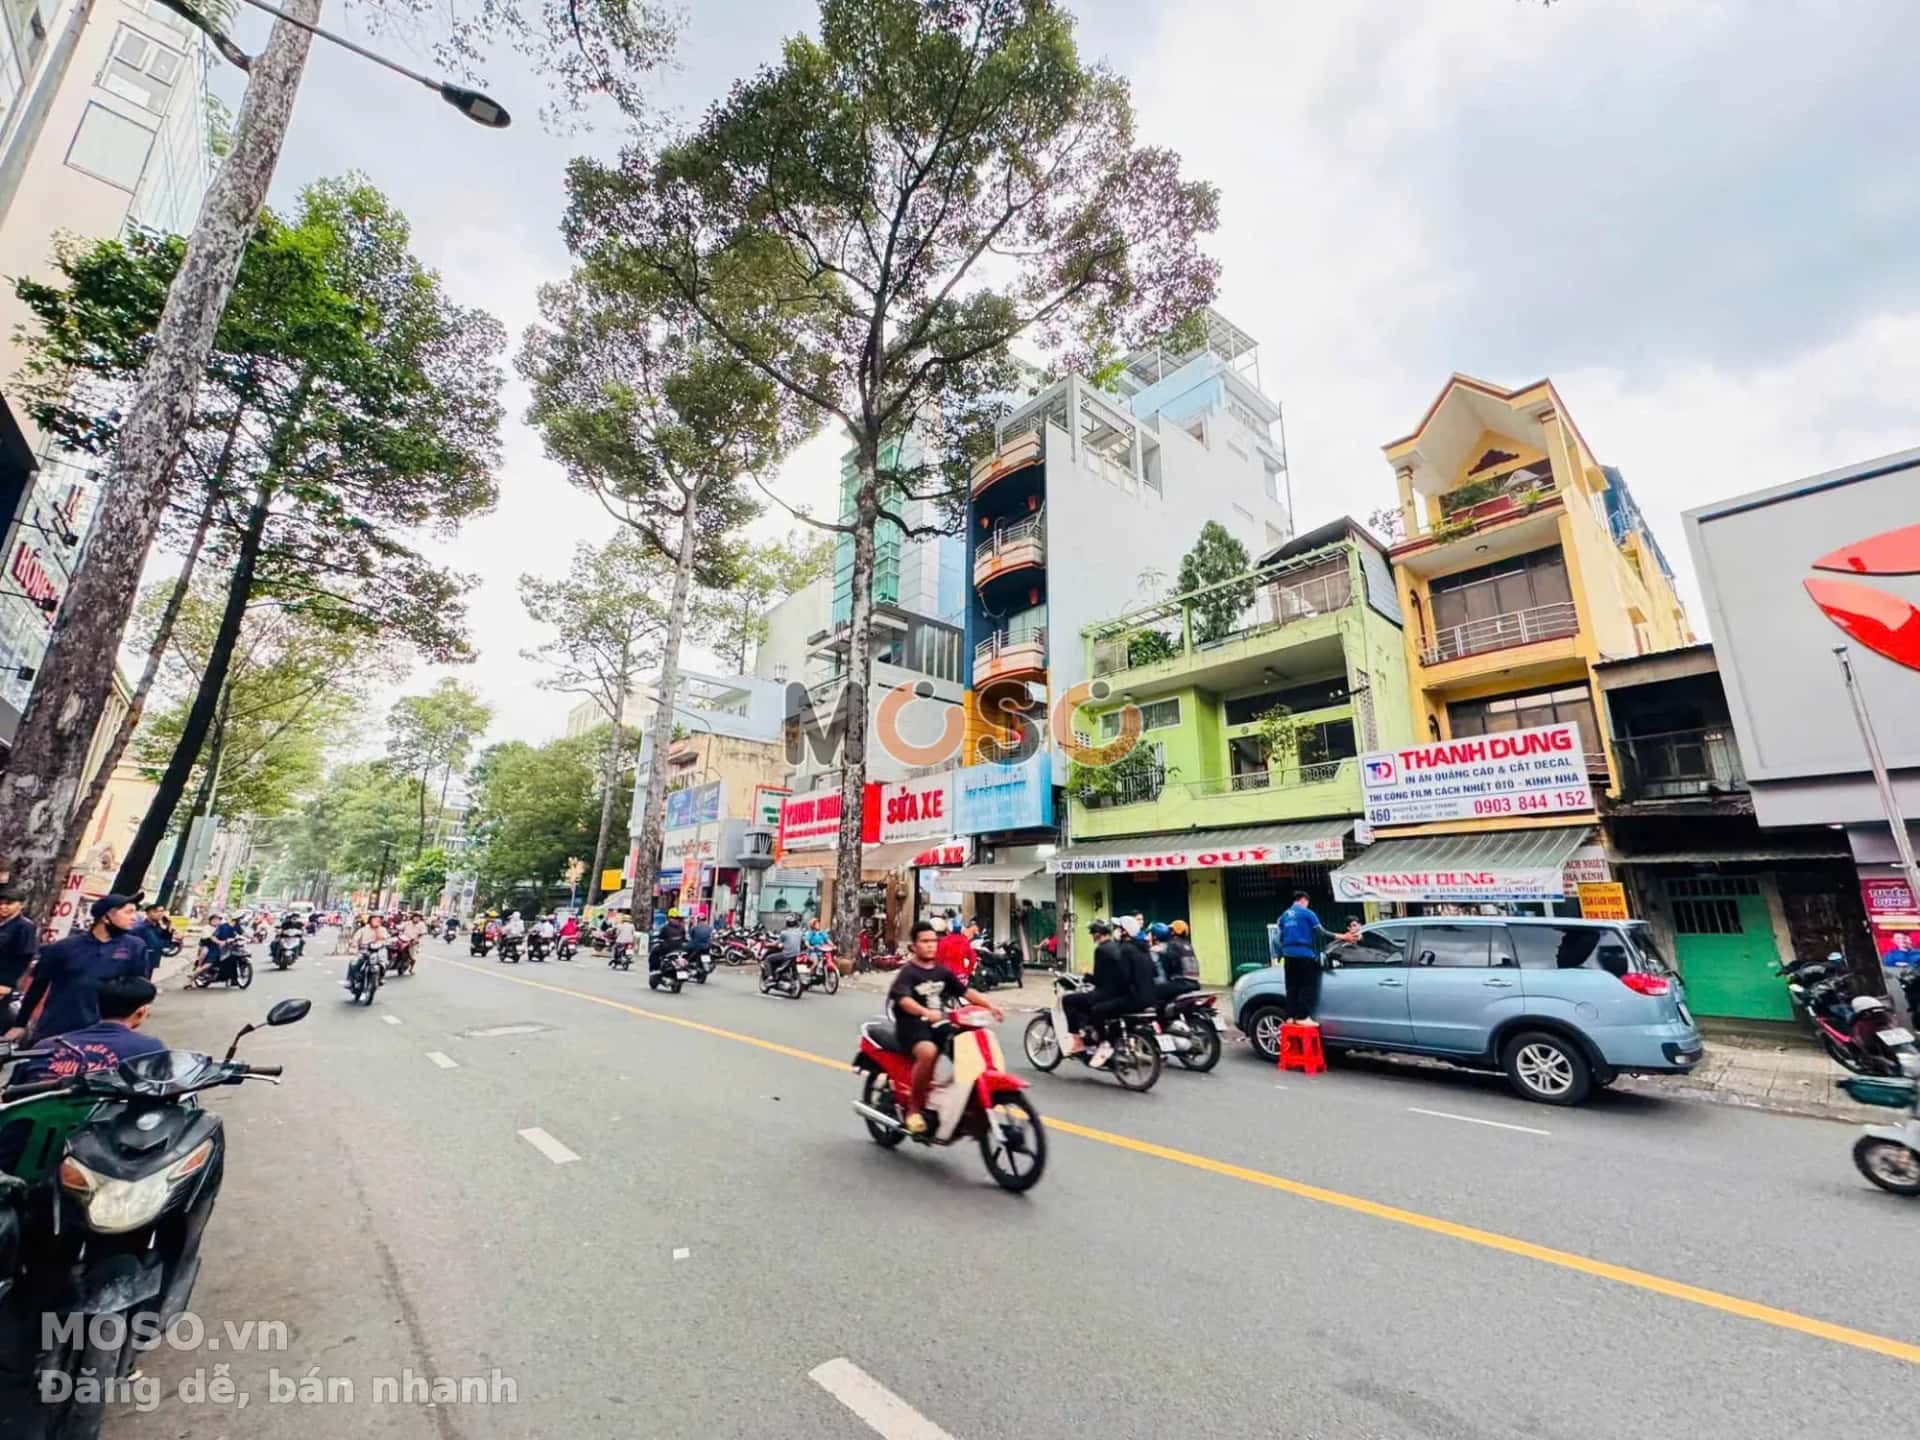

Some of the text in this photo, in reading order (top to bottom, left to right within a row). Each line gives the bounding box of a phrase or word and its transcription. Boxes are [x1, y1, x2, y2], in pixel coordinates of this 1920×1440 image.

[1400, 729, 1572, 770] THANH DUNG
[1534, 757, 1573, 772] DECAL
[886, 786, 944, 824] SỬA XE
[1410, 787, 1433, 800] FILM
[1369, 807, 1391, 823] 460
[1474, 798, 1512, 815] 0903
[1518, 794, 1548, 811] 844
[1555, 790, 1587, 807] 152
[1364, 873, 1429, 886] THANH
